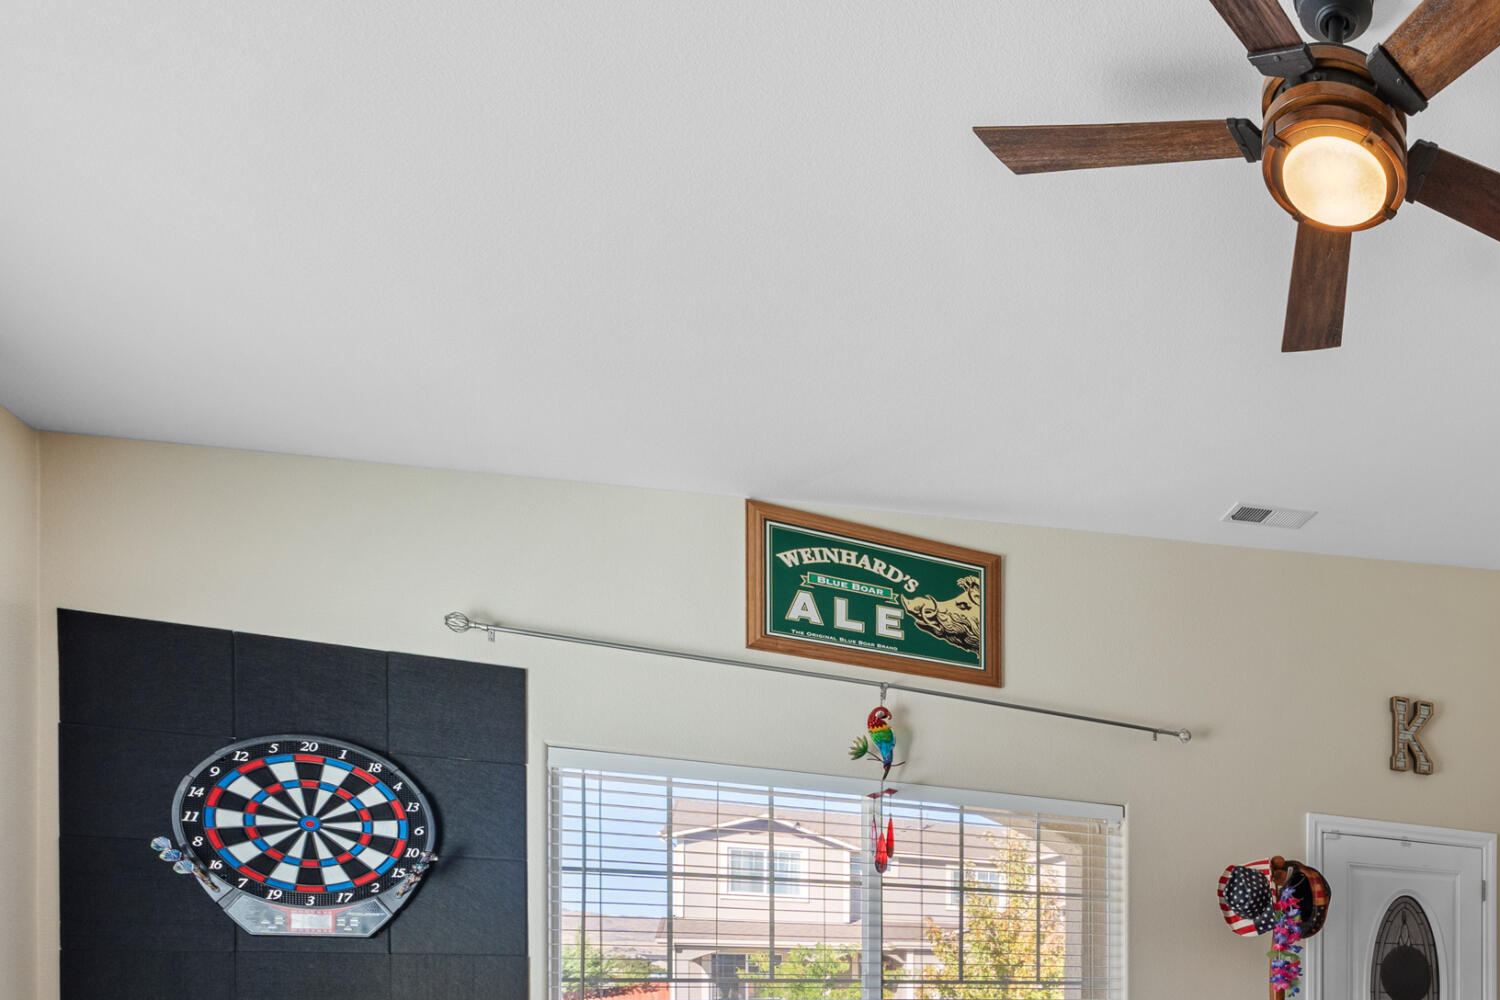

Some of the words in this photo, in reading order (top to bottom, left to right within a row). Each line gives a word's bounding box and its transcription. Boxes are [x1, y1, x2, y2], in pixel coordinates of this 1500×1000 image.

[776, 547, 919, 593] WEINHARD'S
[817, 576, 848, 589] BLUE
[851, 583, 884, 596] BOAR
[785, 589, 905, 641] ALE
[1390, 696, 1434, 775] K
[268, 743, 279, 754] 5
[300, 741, 318, 752] 20
[232, 750, 249, 762] 12
[339, 749, 347, 759] 1
[209, 766, 220, 777] 9
[368, 762, 382, 773] 18
[187, 786, 205, 798] 14
[393, 782, 402, 792] 4
[406, 802, 420, 812] 13
[181, 810, 199, 822] 11
[414, 825, 424, 836] 6
[192, 836, 203, 847] 8
[405, 848, 419, 858] 10
[208, 859, 222, 870] 16
[391, 867, 405, 878] 15
[237, 878, 248, 888] 7
[370, 882, 380, 893] 2
[266, 889, 282, 900] 19
[336, 892, 353, 903] 17
[306, 896, 315, 906] 3
